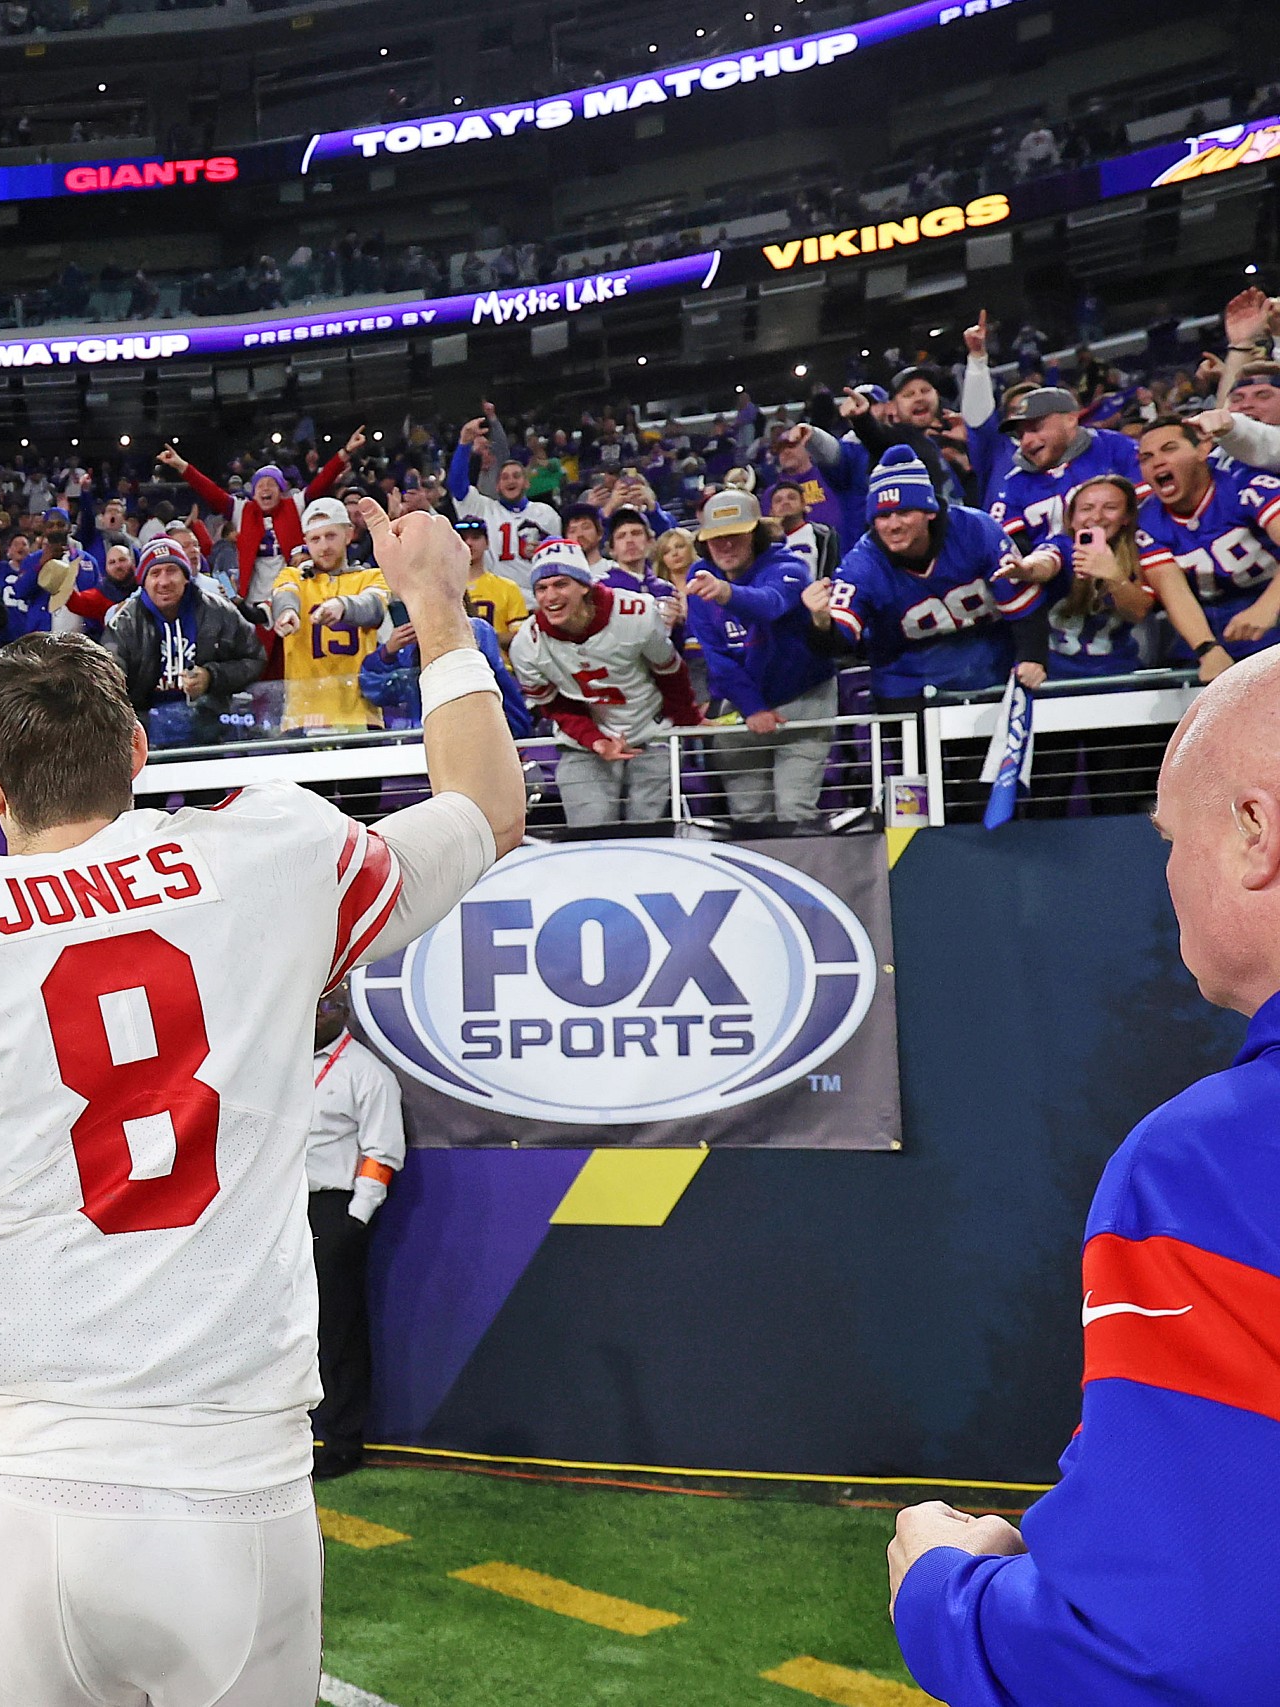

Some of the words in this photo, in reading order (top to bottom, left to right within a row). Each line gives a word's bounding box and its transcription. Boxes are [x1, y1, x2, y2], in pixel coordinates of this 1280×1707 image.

[352, 99, 574, 158] TODAY'S
[583, 32, 859, 120] MATCHUP
[64, 157, 238, 192] GIANTS
[762, 193, 1011, 270] VIKINGS
[244, 315, 393, 347] PRESENTED
[402, 309, 437, 326] BY
[460, 888, 751, 1014] FOX
[461, 1013, 756, 1060] SPORTS
[40, 928, 222, 1236] 8
[808, 1073, 842, 1094] TM
